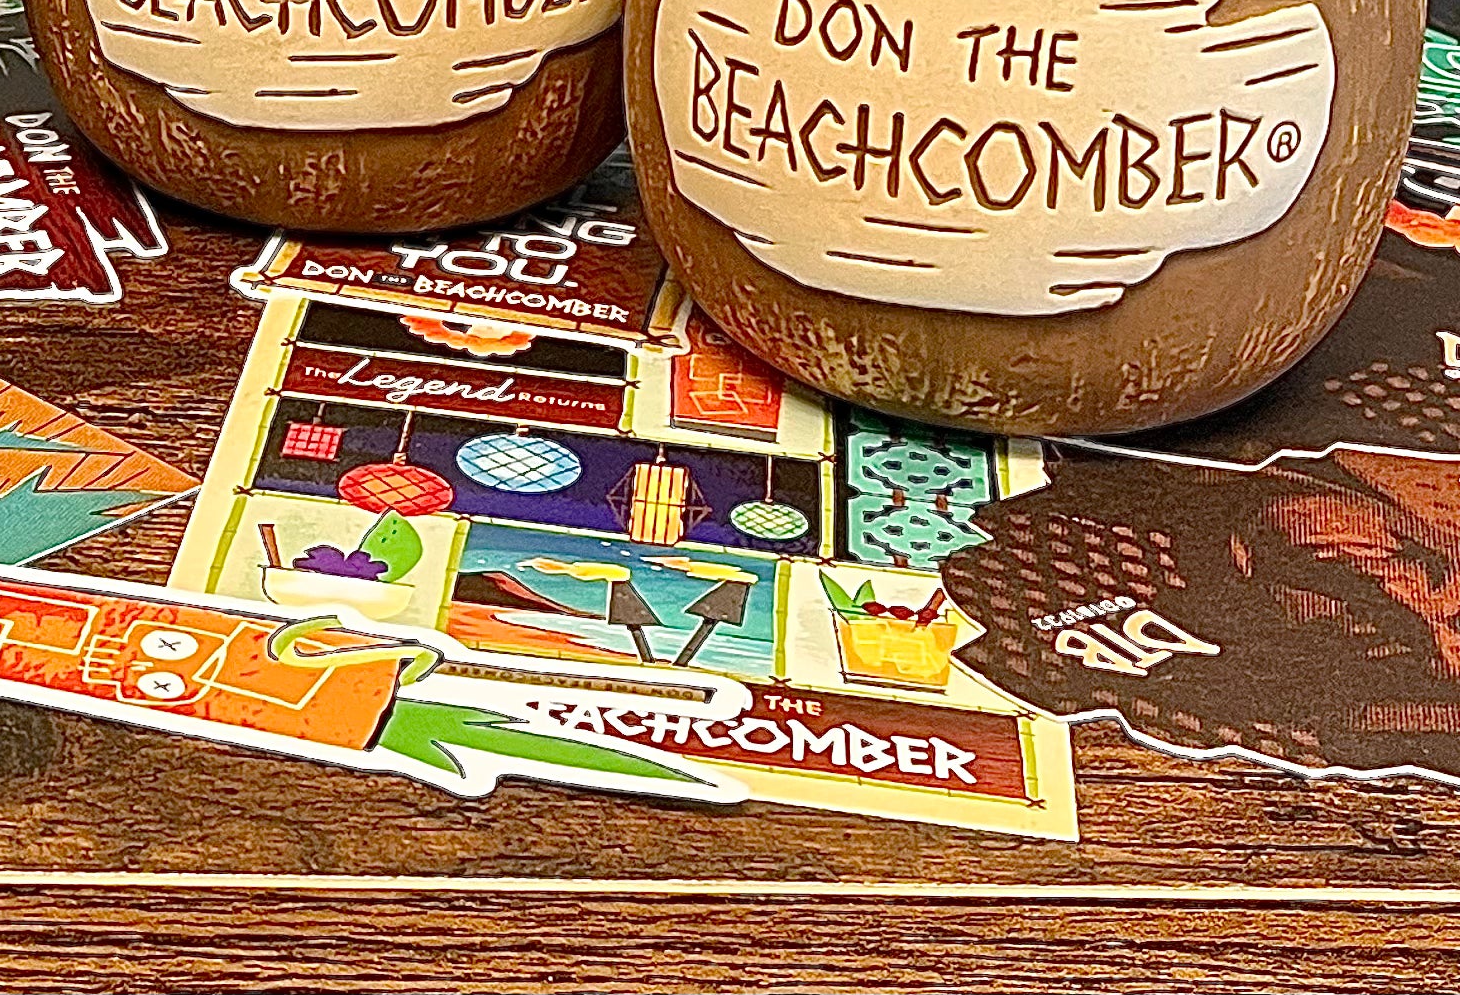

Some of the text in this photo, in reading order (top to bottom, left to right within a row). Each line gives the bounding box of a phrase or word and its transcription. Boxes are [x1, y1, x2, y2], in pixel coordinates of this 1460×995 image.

[958, 26, 1079, 92] THE
[5, 112, 81, 195] DON THE
[392, 240, 578, 288] YOU.
[475, 231, 577, 260] TO
[301, 259, 374, 284] DON
[413, 275, 630, 323] BEACHCOMBER
[337, 358, 516, 403] Legend
[1055, 609, 1221, 677] DTB
[764, 694, 822, 718] THE
[533, 701, 978, 785] EACHCOMBER
